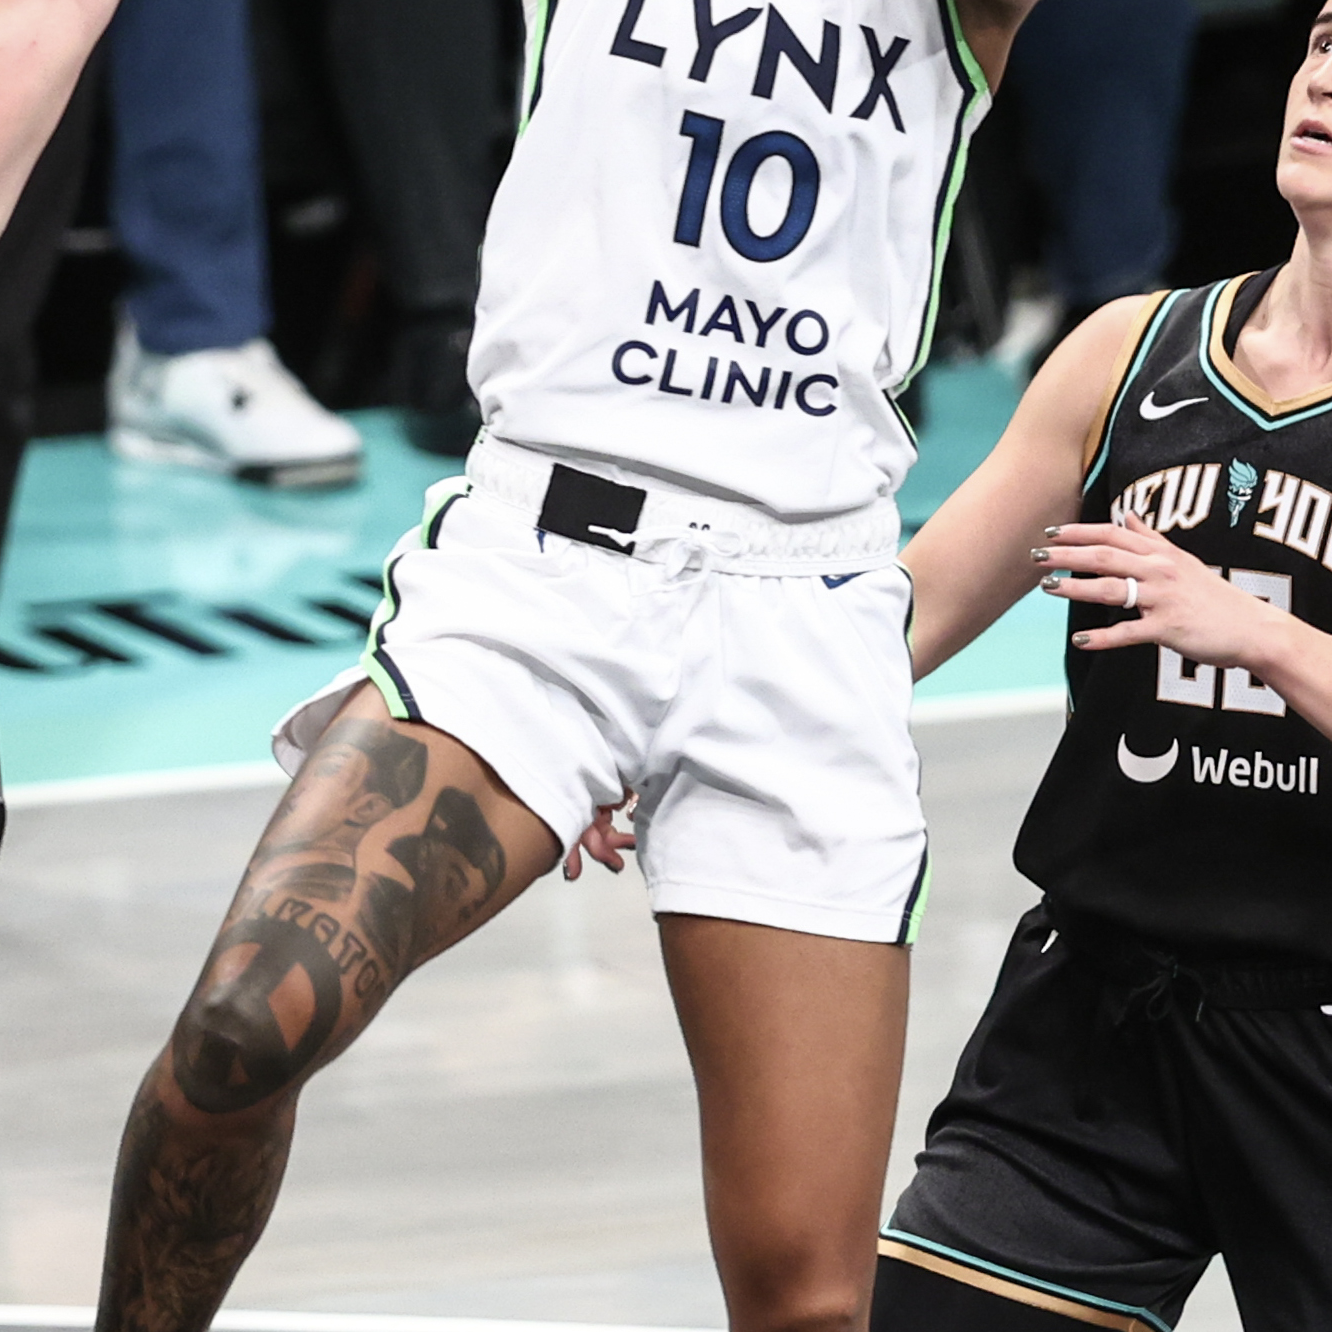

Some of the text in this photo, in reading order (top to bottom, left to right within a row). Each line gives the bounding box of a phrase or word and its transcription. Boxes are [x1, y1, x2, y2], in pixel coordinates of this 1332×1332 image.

[673, 109, 821, 264] 10
[645, 279, 830, 356] MAYO
[612, 340, 838, 418] CLINIC
[1191, 746, 1320, 795] Webull
